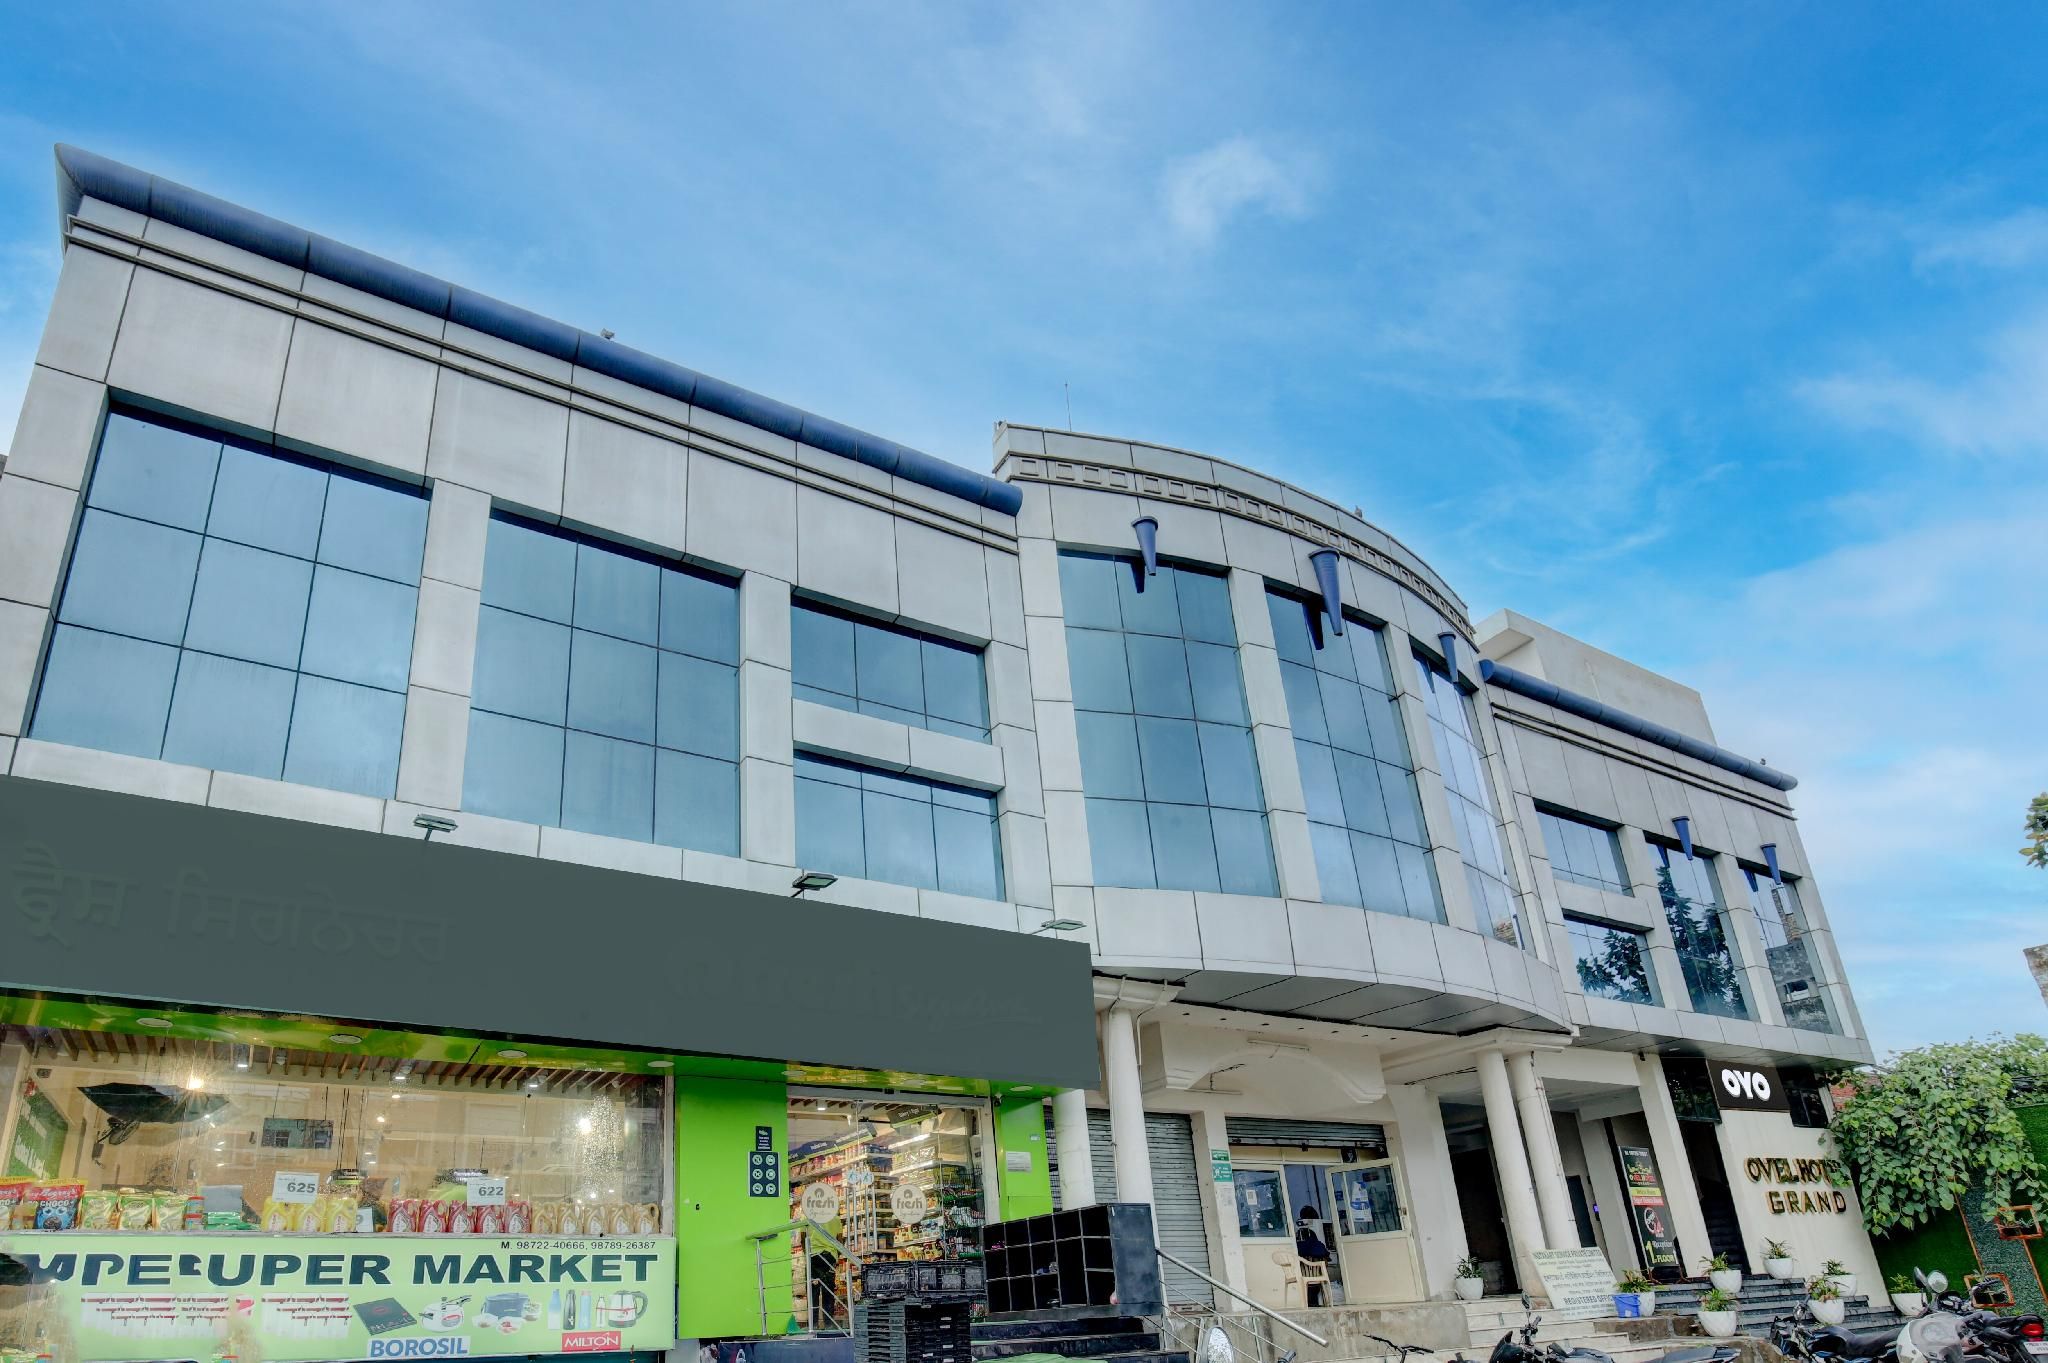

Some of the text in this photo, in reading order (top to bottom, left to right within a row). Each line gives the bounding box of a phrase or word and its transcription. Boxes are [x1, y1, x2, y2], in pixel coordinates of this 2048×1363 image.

[1721, 1068, 1770, 1101] OYO
[1743, 1157, 1841, 1185] OVEL HOT
[287, 1182, 315, 1193] 625
[478, 1186, 504, 1197] 622
[807, 1197, 835, 1209] fresh
[896, 1197, 923, 1209] fresh
[1765, 1191, 1847, 1215] GRAND
[516, 1241, 588, 1251] 98722-40666,
[591, 1241, 656, 1250] 98789-26387
[1656, 1254, 1674, 1263] FLOOR
[413, 1254, 658, 1284] MARKET
[1563, 1294, 1613, 1305] REGISTERED OFFIC
[370, 1336, 468, 1357] BOROSIL
[564, 1333, 620, 1349] MILTON
